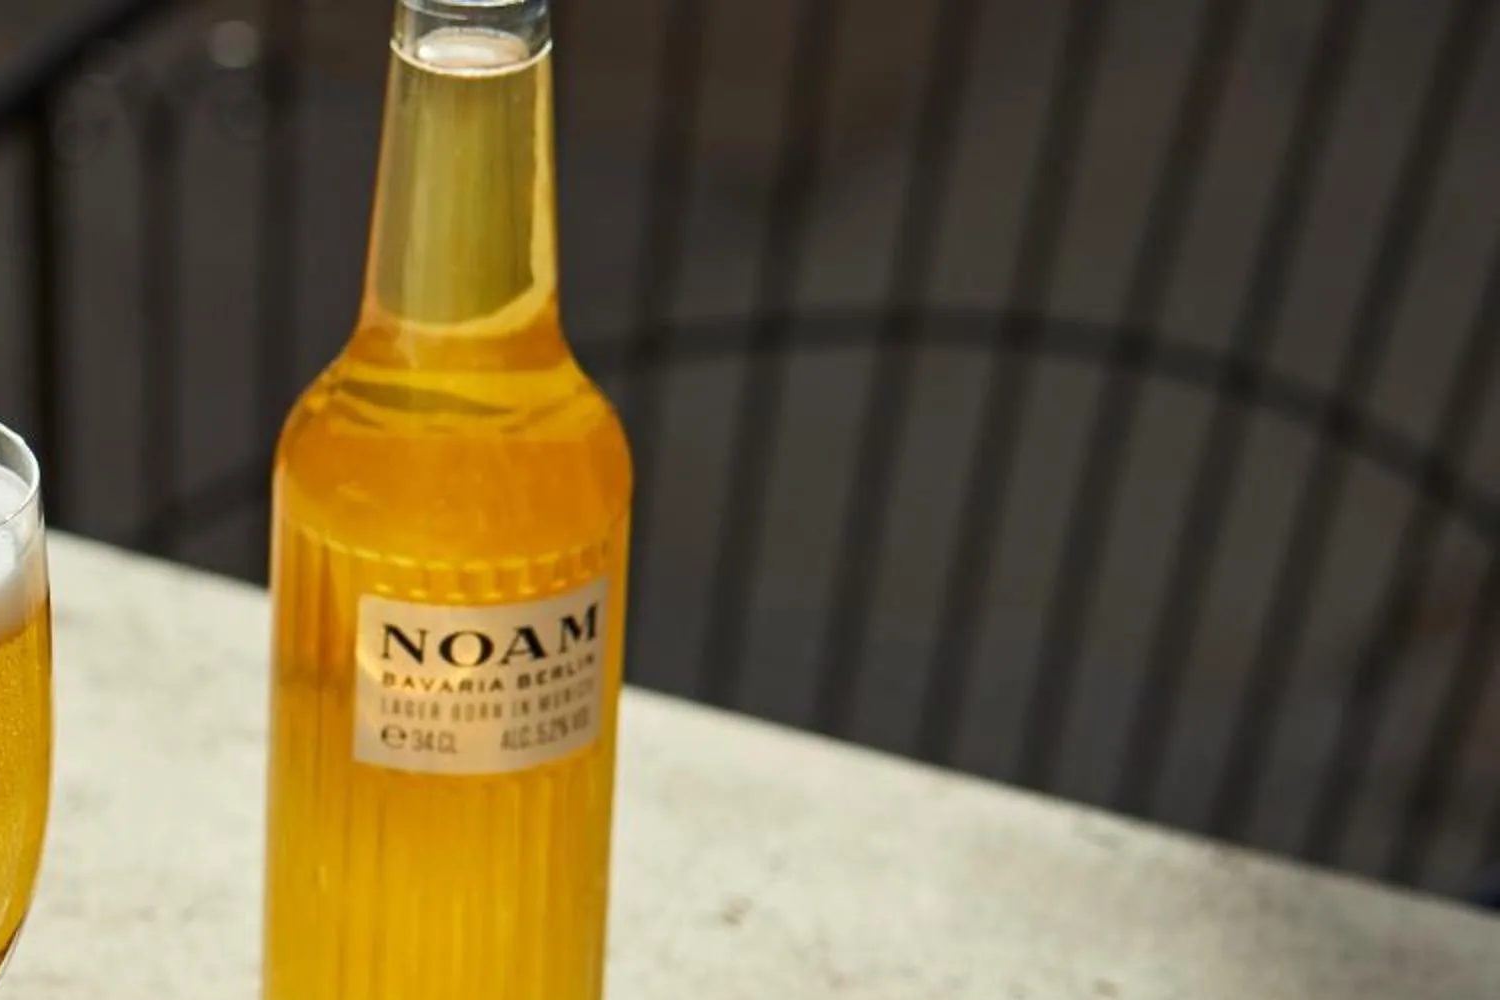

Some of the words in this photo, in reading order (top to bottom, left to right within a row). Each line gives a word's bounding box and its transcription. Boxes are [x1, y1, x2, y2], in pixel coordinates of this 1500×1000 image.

[380, 602, 598, 667] NOAM
[382, 672, 505, 694] BAVARIA
[517, 653, 596, 690] BERLIN
